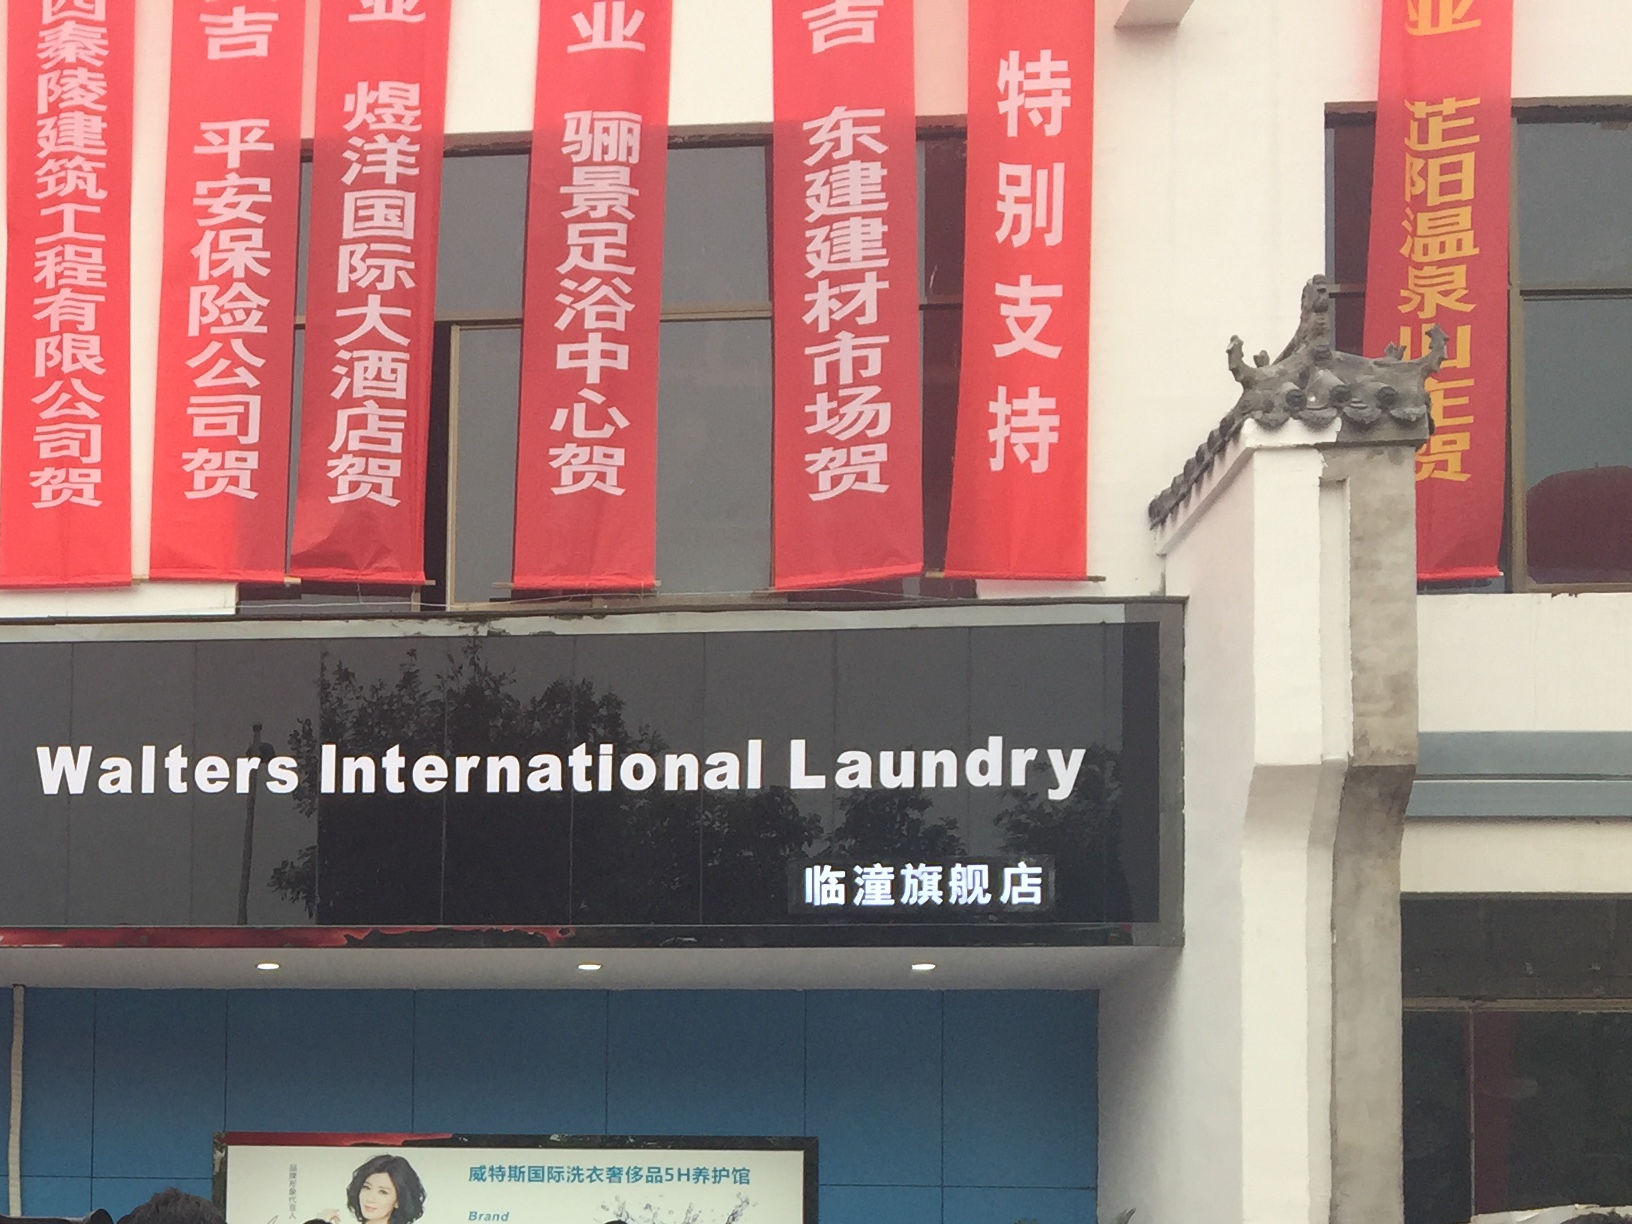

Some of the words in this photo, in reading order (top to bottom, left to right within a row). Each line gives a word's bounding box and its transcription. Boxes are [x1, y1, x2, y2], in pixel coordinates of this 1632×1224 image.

[567, 0, 646, 53] 业
[802, 0, 884, 54] 吉
[326, 80, 423, 508] 煜洋国际大酒店贺
[988, 49, 1072, 474] 特别支持
[181, 118, 275, 500] 平安保险公司贺
[548, 110, 642, 497] 骊景足浴中心贺
[802, 106, 892, 502] 东建建材市场贺
[36, 744, 298, 795] Walters
[320, 739, 762, 795] International
[790, 734, 1086, 802] Laundry
[804, 862, 1044, 907] 临潼旗舰店
[468, 1164, 751, 1185] 威特斯国际洗衣奢侈品5H养护馆
[468, 1210, 510, 1222] Brand
